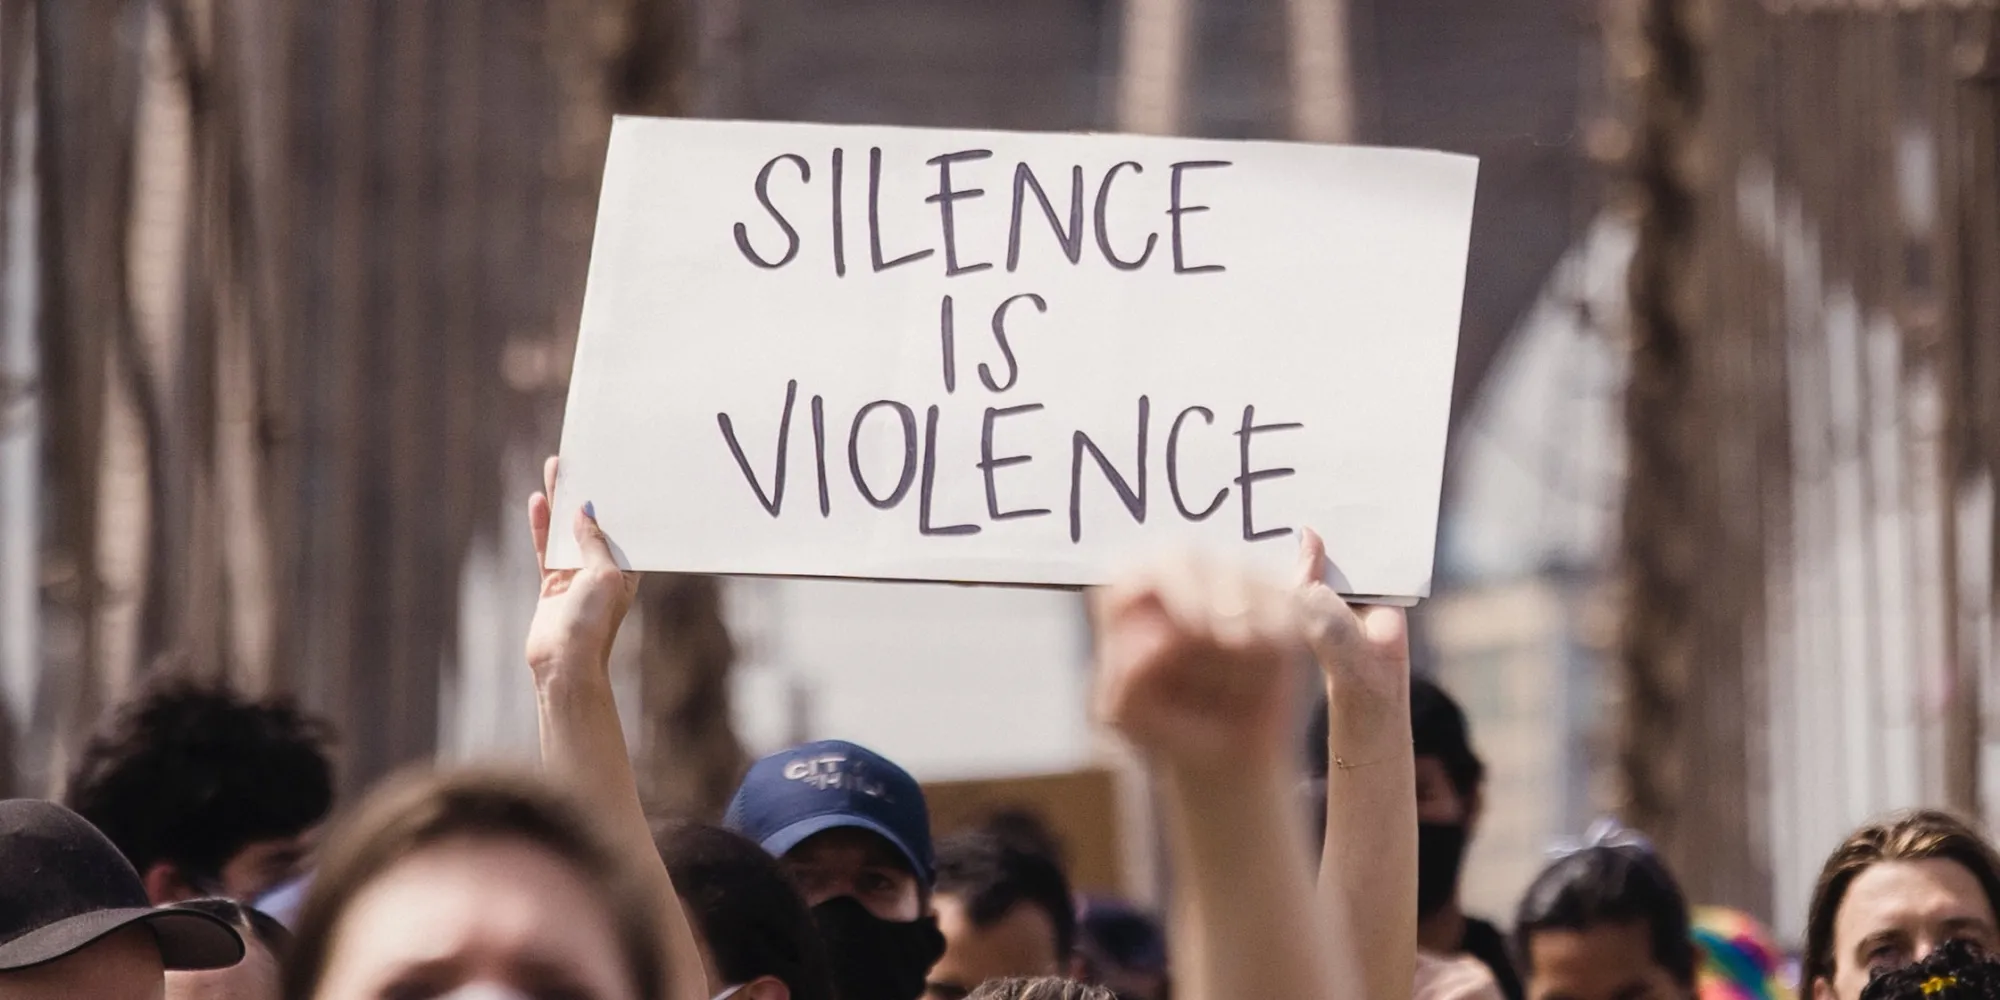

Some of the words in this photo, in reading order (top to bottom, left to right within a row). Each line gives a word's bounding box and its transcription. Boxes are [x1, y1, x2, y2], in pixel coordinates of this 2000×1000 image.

[733, 146, 1233, 278] SILENCE
[941, 293, 1047, 393] IS
[716, 379, 1303, 543] VIOLENCE
